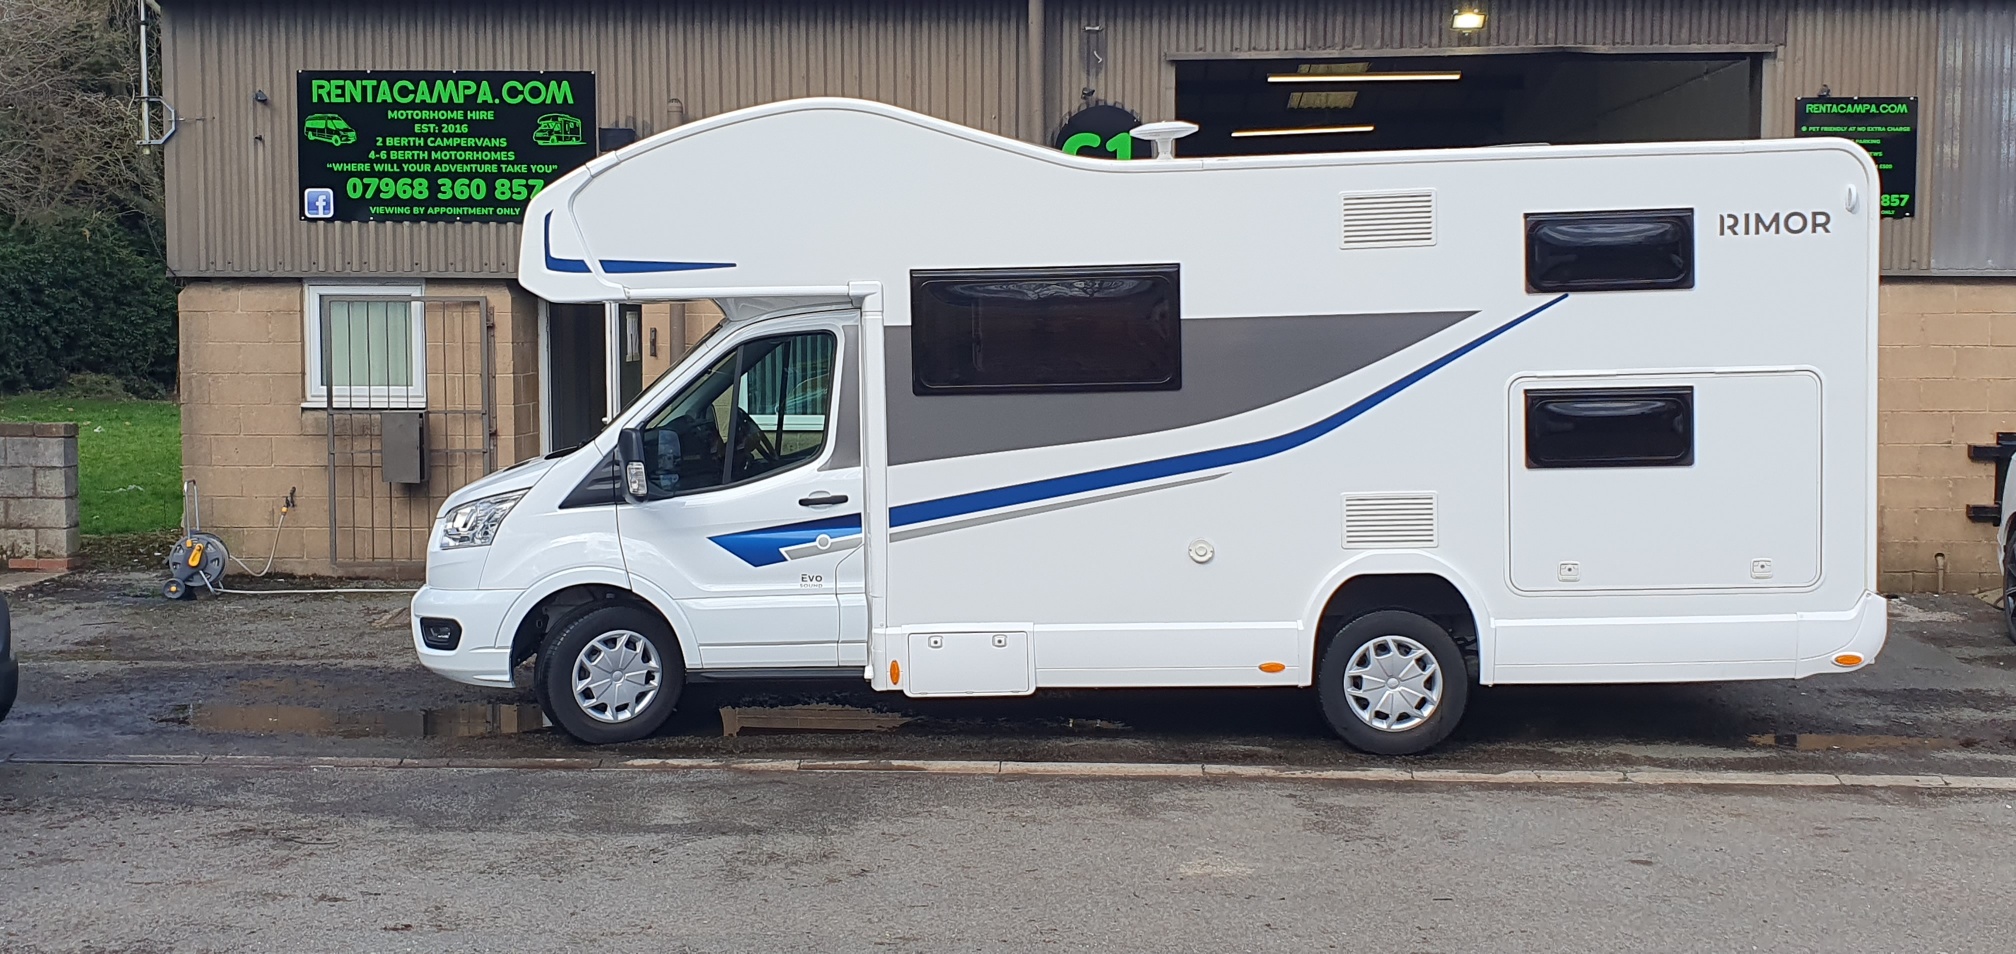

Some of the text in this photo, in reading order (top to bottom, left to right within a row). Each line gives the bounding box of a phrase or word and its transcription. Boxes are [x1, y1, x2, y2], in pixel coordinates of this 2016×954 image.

[311, 79, 575, 105] RENTACAMPA.COM
[1805, 103, 1909, 114] RENTACAMPA.COM
[387, 109, 495, 121] MOTORHOME HIRE
[414, 123, 470, 134] EST: 2016
[376, 136, 508, 148] 2 BERTH CAMPERVANS
[368, 150, 516, 161] 4-6 BERTH MOTORHOMES
[373, 163, 400, 173] WILL
[402, 163, 432, 173] YOUR
[433, 163, 499, 173] ADVENTURE
[500, 164, 529, 174] TAKE
[346, 177, 545, 201] 07968 360 857
[1881, 193, 1911, 208] 857
[369, 206, 521, 216] VIEWING BY APPOINTMENT ONLY
[1719, 211, 1831, 236] RIMOR
